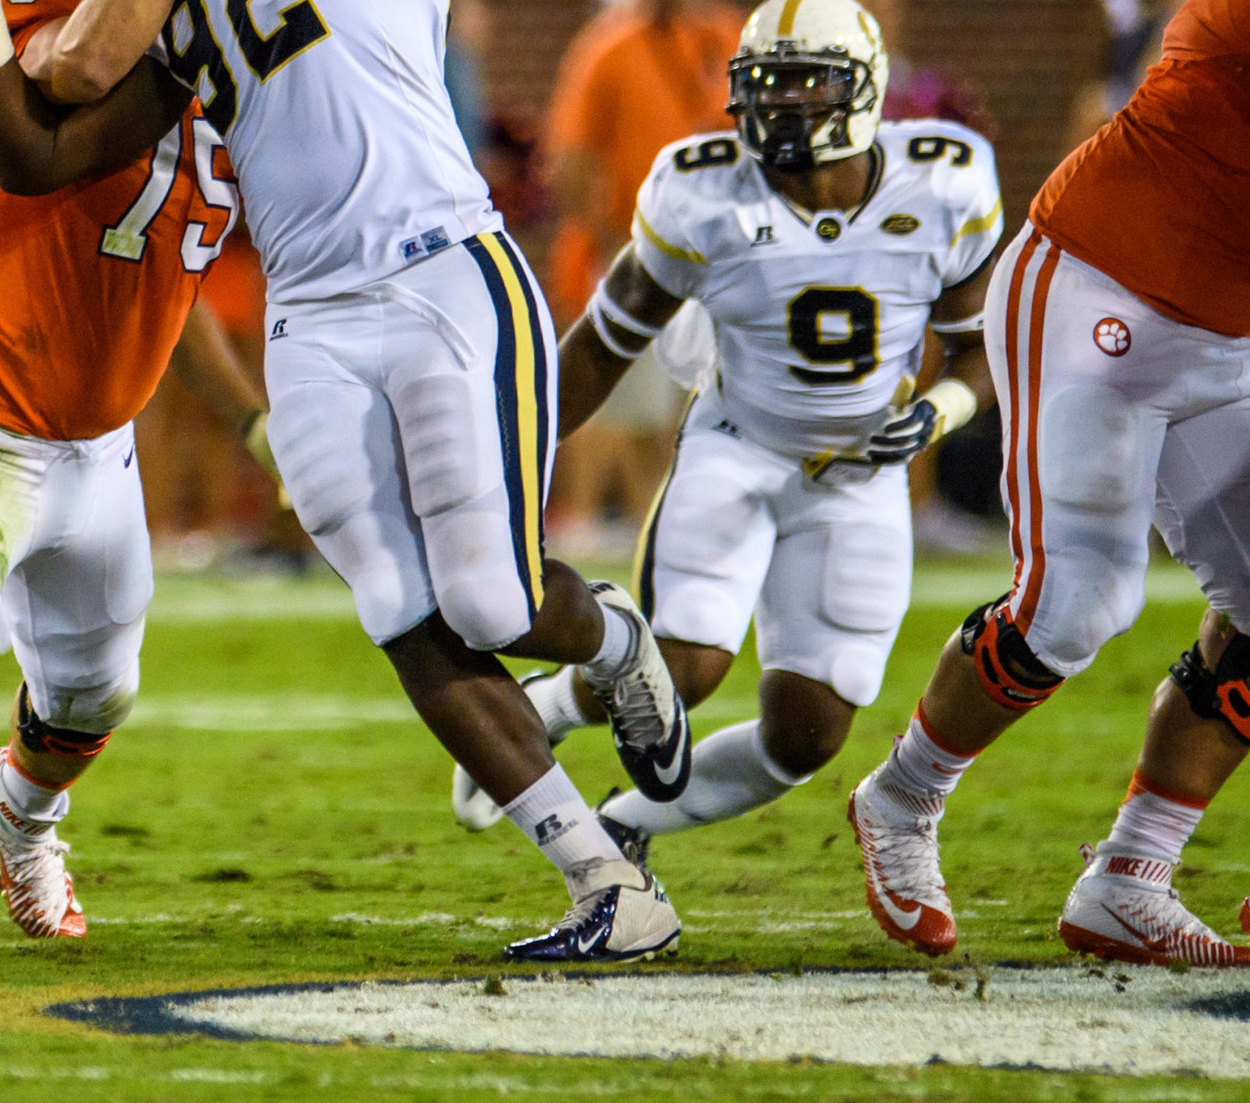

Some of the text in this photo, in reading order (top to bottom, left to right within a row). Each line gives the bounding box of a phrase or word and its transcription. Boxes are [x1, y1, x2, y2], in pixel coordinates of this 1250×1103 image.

[674, 139, 739, 174] 9
[907, 135, 973, 167] 9
[786, 284, 882, 386] 9
[1105, 856, 1145, 876] NIKE
